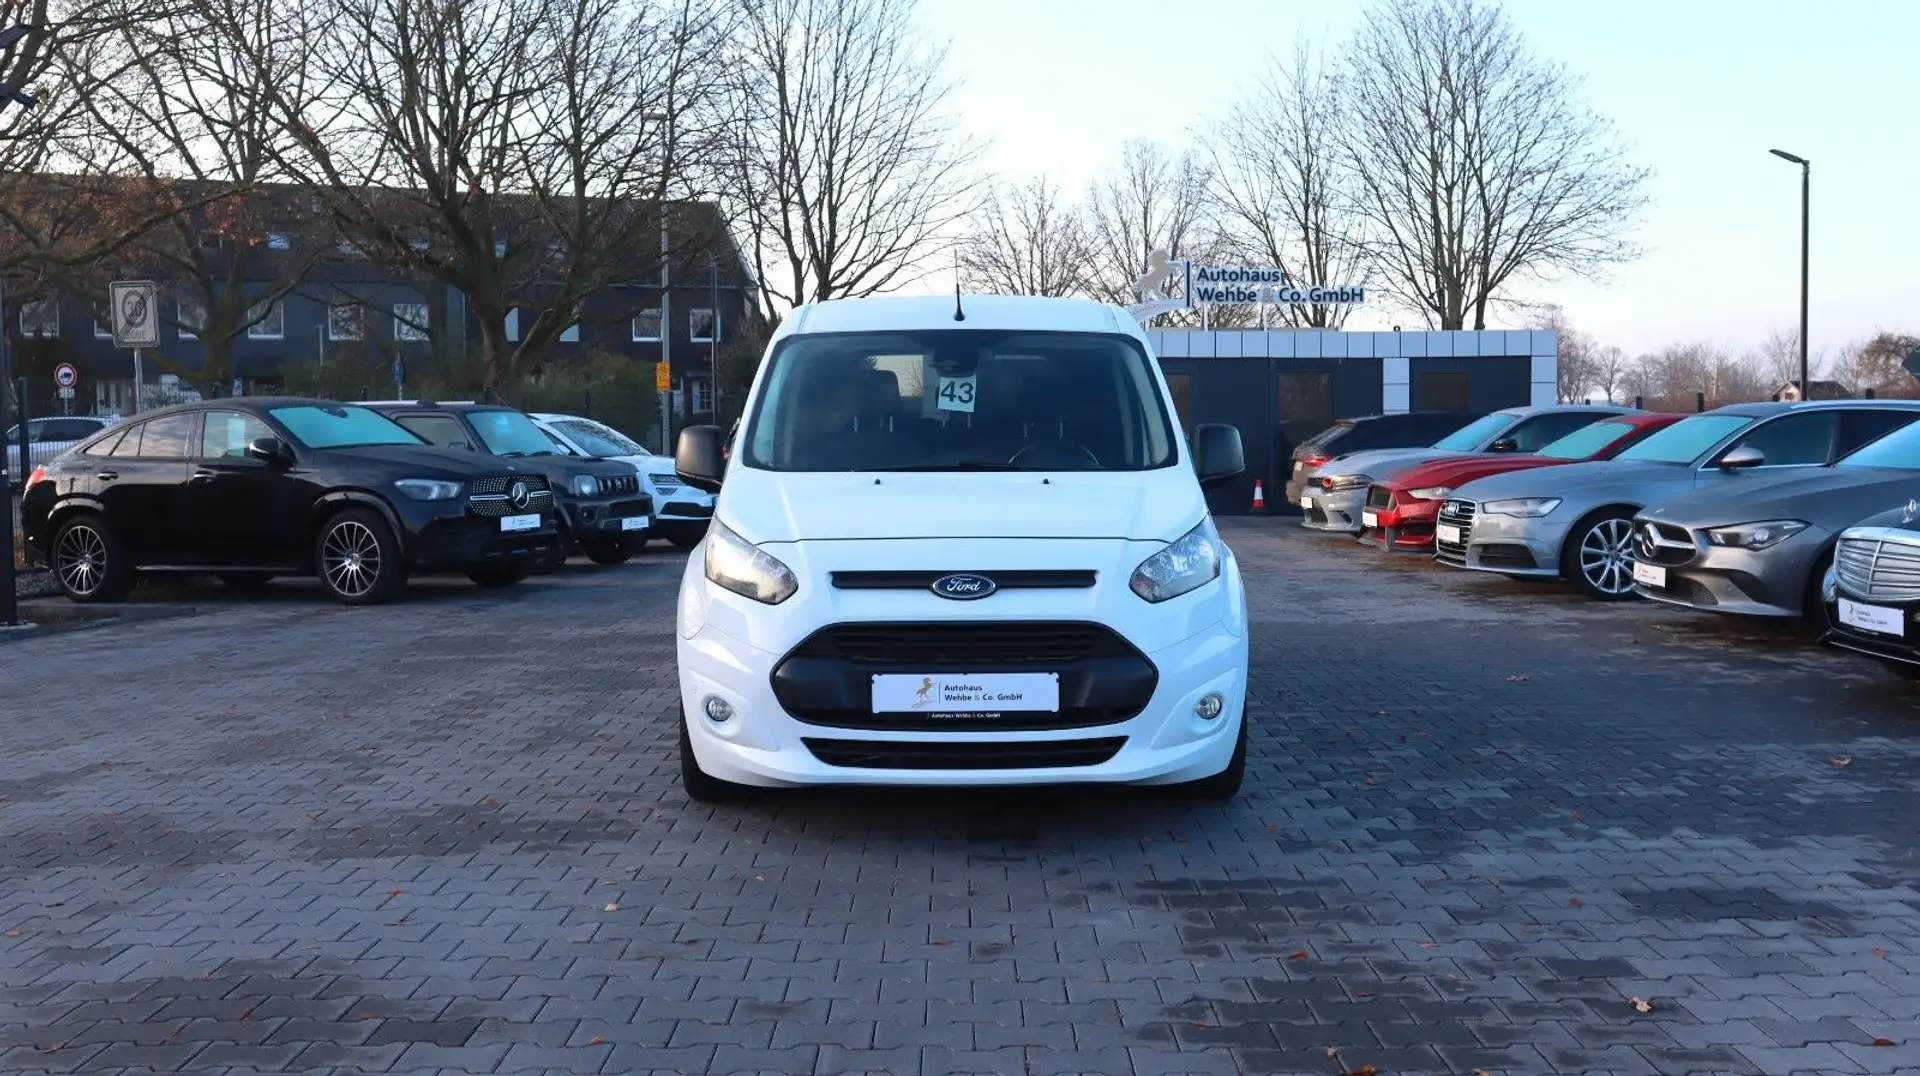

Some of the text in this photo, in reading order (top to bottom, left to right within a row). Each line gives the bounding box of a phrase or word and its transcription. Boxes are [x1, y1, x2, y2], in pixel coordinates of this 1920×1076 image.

[1197, 267, 1281, 282] Autohaus
[1198, 286, 1364, 302] Wehbe & Co. GmbH
[940, 381, 974, 404] 43
[947, 578, 980, 592] Ford
